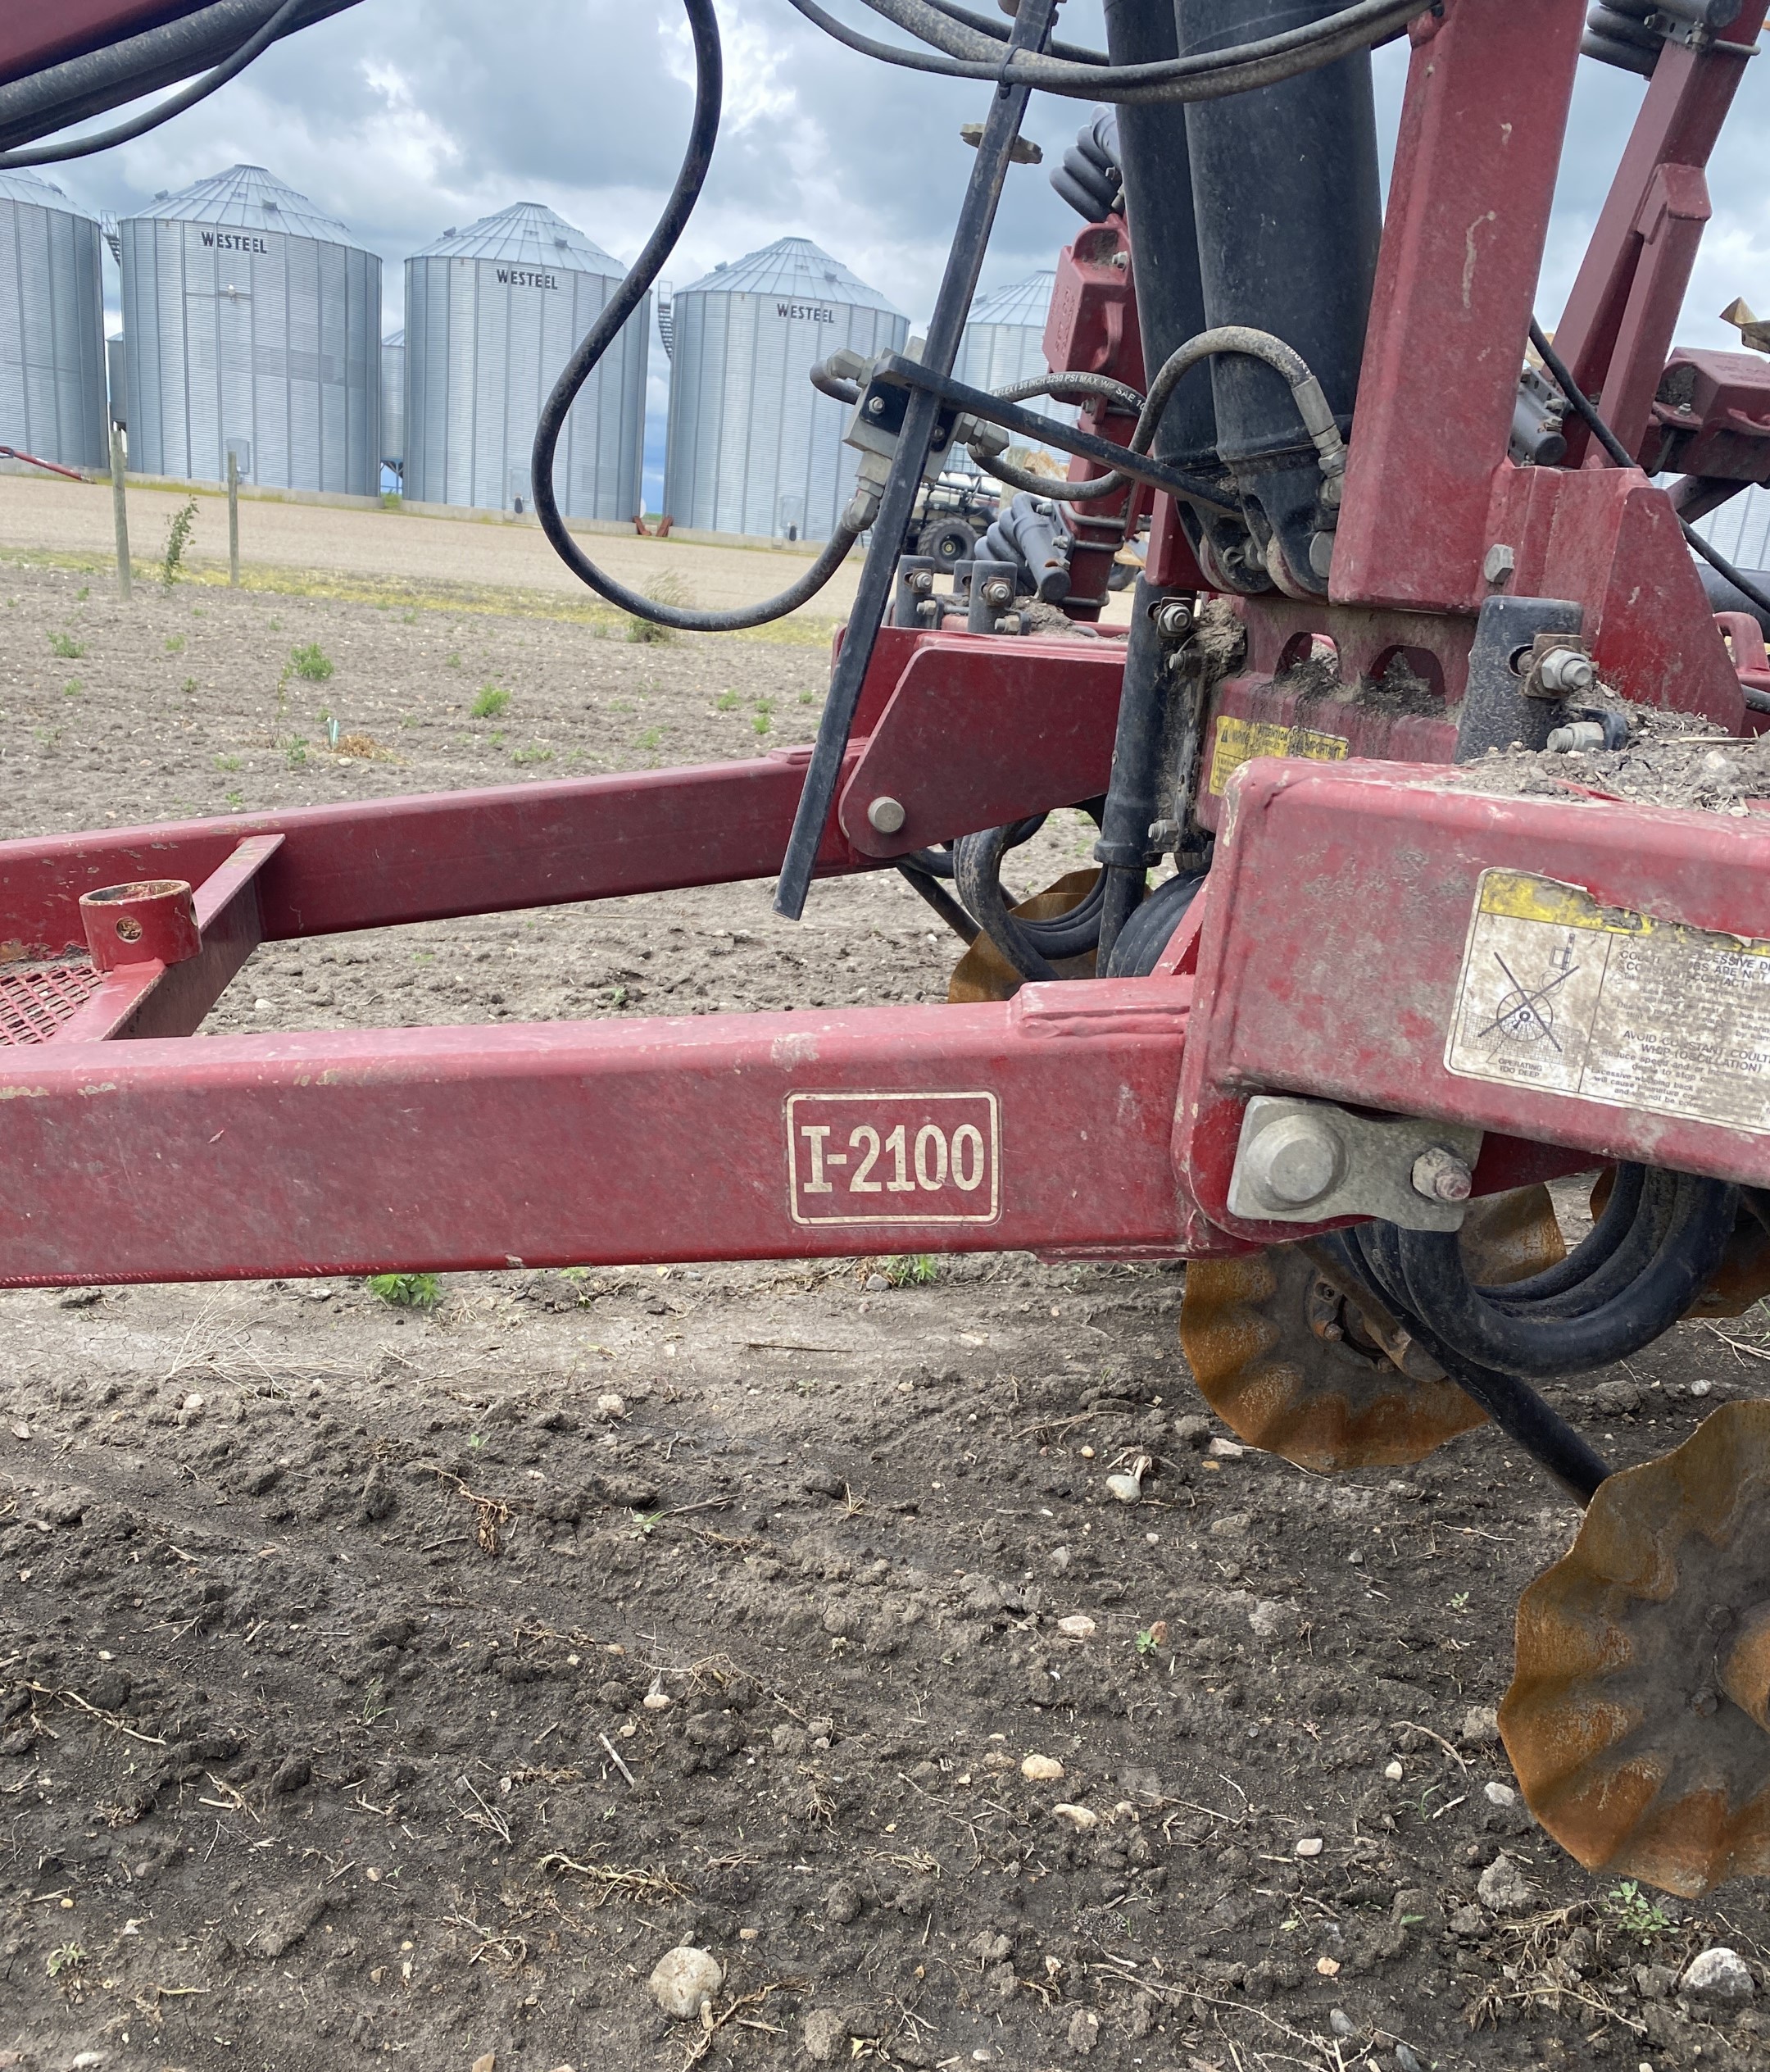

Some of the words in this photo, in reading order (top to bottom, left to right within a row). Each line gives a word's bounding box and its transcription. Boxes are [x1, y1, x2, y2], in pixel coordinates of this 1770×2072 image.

[201, 231, 267, 254] WESTEEL
[497, 269, 558, 289] WESTEEL
[777, 303, 834, 323] WESTEEL
[1029, 377, 1046, 388] INCH
[1046, 375, 1064, 384] 3250
[1064, 374, 1078, 383] PSI
[1079, 375, 1099, 385] MAX
[1116, 387, 1136, 402] SAE
[1692, 973, 1747, 988] CONACT
[1742, 970, 1768, 982] NOT
[1622, 1030, 1657, 1043] AVOID
[1662, 1037, 1726, 1055] COSTANT
[1731, 1049, 1770, 1064] COULT
[1498, 1058, 1542, 1072] OPERATING
[1602, 1049, 1636, 1061] Reduce
[1672, 1061, 1690, 1070] and
[1500, 1066, 1515, 1074] TOO
[1518, 1069, 1540, 1078] DEEP
[1591, 1068, 1632, 1079] Excessive
[1673, 1082, 1693, 1092] back
[1662, 1068, 1672, 1076] to
[1675, 1071, 1696, 1082] stop
[1610, 1079, 1635, 1088] cause
[1649, 1093, 1661, 1102] not
[1678, 1100, 1712, 1109] cover
[801, 1123, 984, 1193] I-2100
